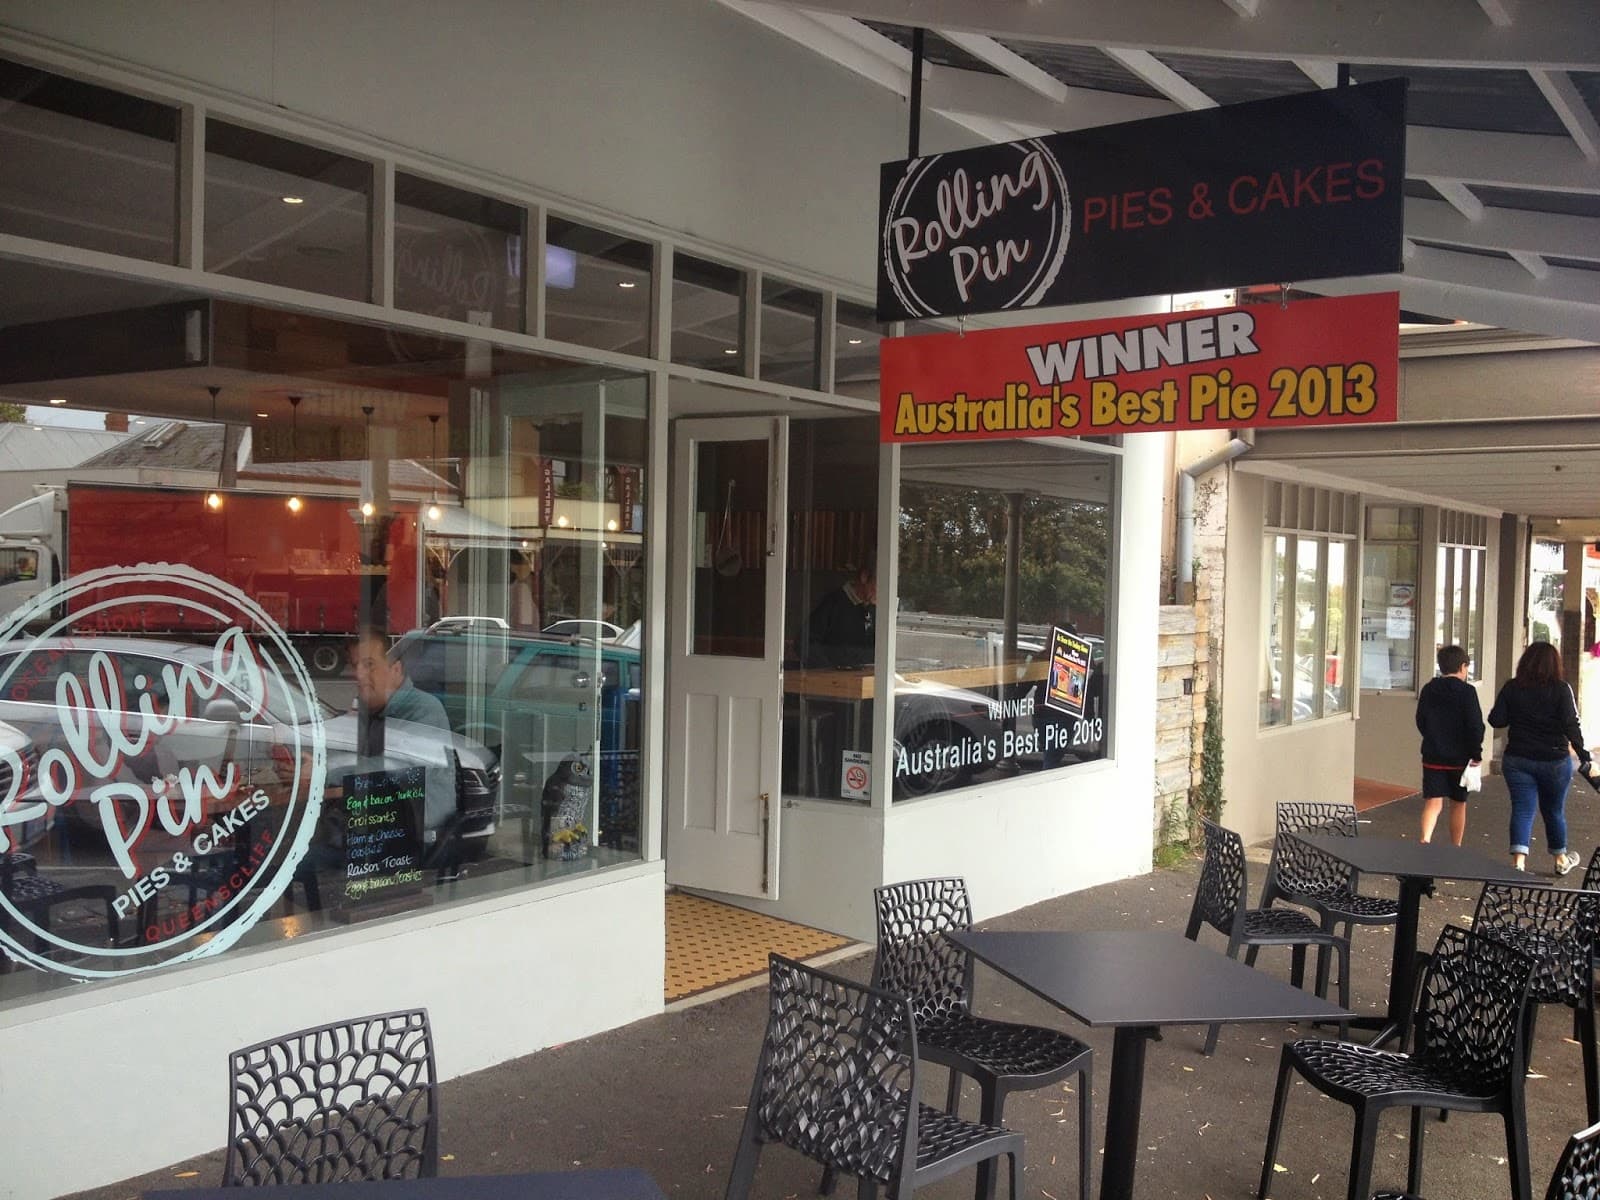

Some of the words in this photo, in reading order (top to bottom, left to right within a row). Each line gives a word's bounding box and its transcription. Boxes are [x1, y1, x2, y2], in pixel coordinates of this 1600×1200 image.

[891, 150, 1050, 274] Rolling
[1083, 187, 1174, 235] PIES
[1188, 181, 1216, 219] &
[1227, 158, 1387, 215] CAKES
[949, 239, 1031, 303] Pin
[1025, 311, 1259, 387] WINNER
[894, 382, 1081, 436] Australia's
[1090, 378, 1180, 429] Best
[1189, 368, 1258, 423] Pie
[1268, 362, 1378, 418] 2013
[895, 734, 997, 778] Australia's
[1003, 728, 1039, 759] Best
[1045, 721, 1068, 750] Pie
[1072, 717, 1104, 746] 2013
[988, 698, 1035, 721] WINNER
[90, 761, 241, 880] Pin
[111, 865, 171, 920] PIES
[172, 851, 194, 873] &
[193, 788, 270, 855] CAKES
[145, 828, 274, 942] QUEENSCLIFF
[381, 854, 414, 869] Toast
